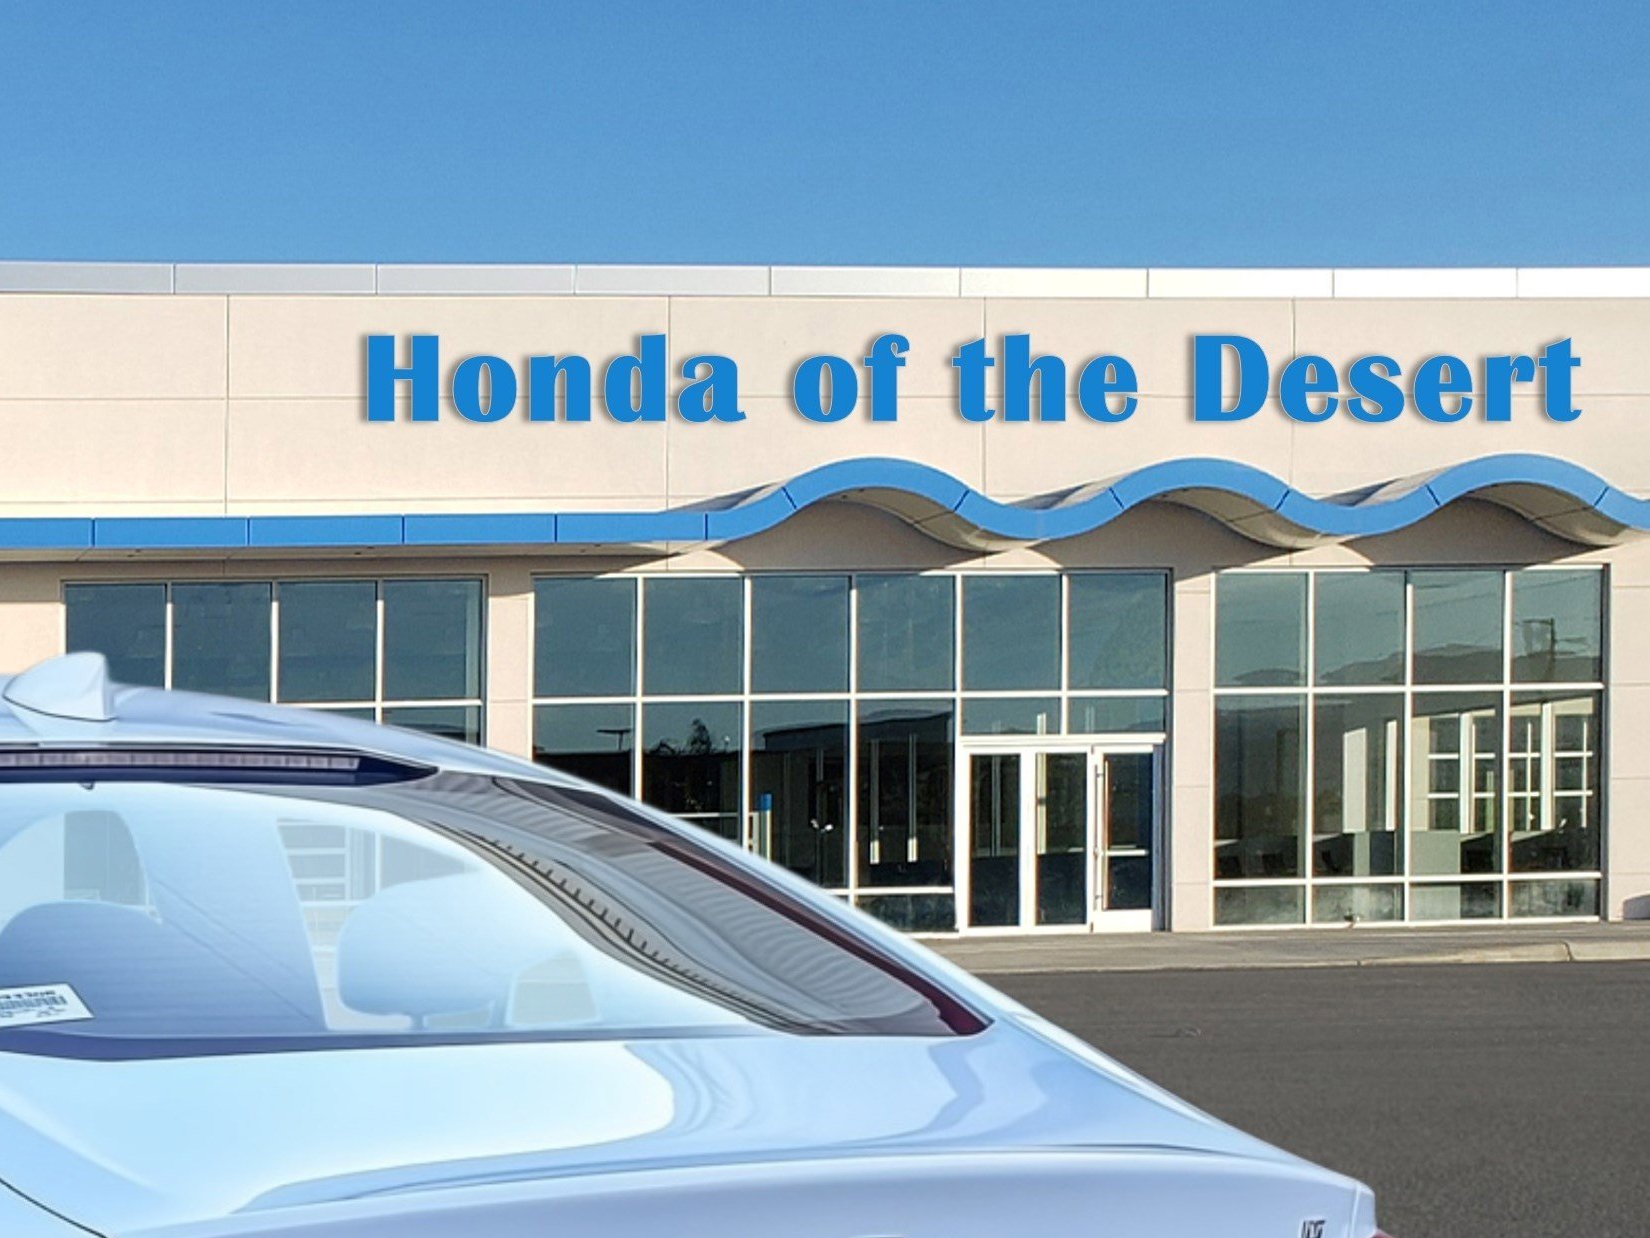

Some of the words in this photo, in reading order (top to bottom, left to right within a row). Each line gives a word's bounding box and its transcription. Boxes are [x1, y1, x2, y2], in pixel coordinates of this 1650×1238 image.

[366, 333, 746, 424] Honda
[793, 333, 910, 424] of
[952, 333, 1140, 424] the
[1193, 334, 1582, 424] Desert
